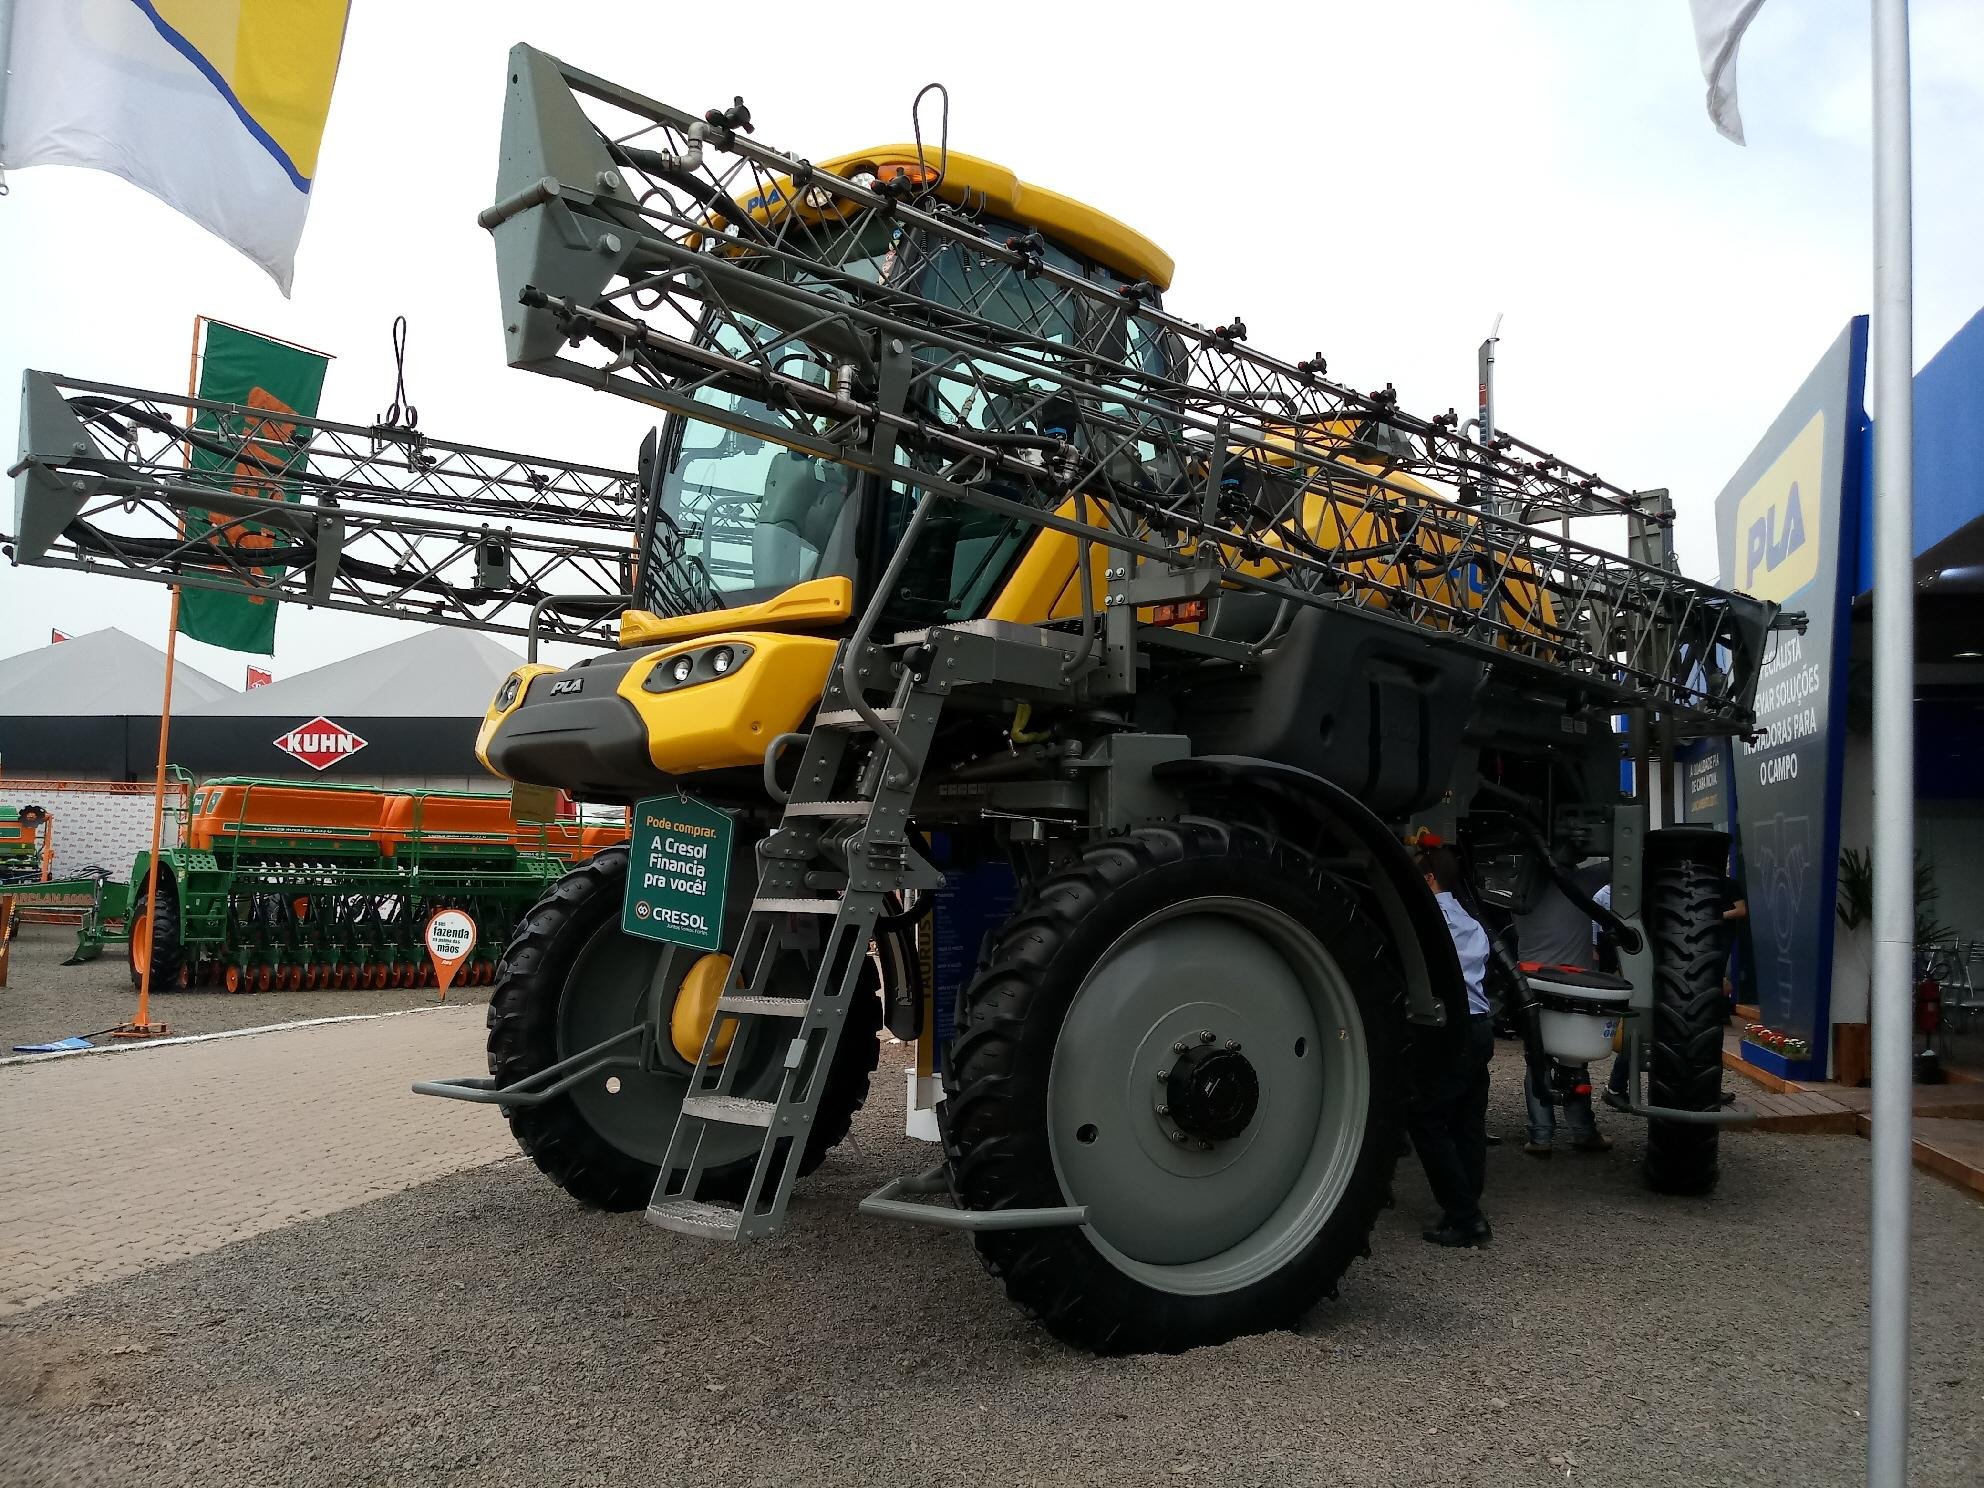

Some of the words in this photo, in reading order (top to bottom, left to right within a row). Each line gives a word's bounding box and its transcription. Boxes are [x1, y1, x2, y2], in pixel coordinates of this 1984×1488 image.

[748, 188, 780, 213] PLA
[1746, 480, 1805, 590] PLA
[550, 679, 583, 694] PLA
[1753, 688, 1774, 717] EVAR
[1776, 664, 1819, 708] SOLUÇÕES
[1794, 707, 1816, 740] PARA
[287, 733, 353, 753] KUHN
[1760, 762, 1767, 786] O
[1768, 753, 1798, 784] CAMPO
[646, 815, 672, 830] Pode
[674, 822, 717, 838] comprar.
[651, 836, 662, 850] A
[665, 838, 708, 859] Cresol
[649, 853, 706, 878] Financia
[644, 873, 666, 888] pra
[670, 878, 707, 896] você!
[653, 907, 708, 930] CRESOL
[434, 926, 469, 939] fazenda
[437, 943, 460, 953] mãos
